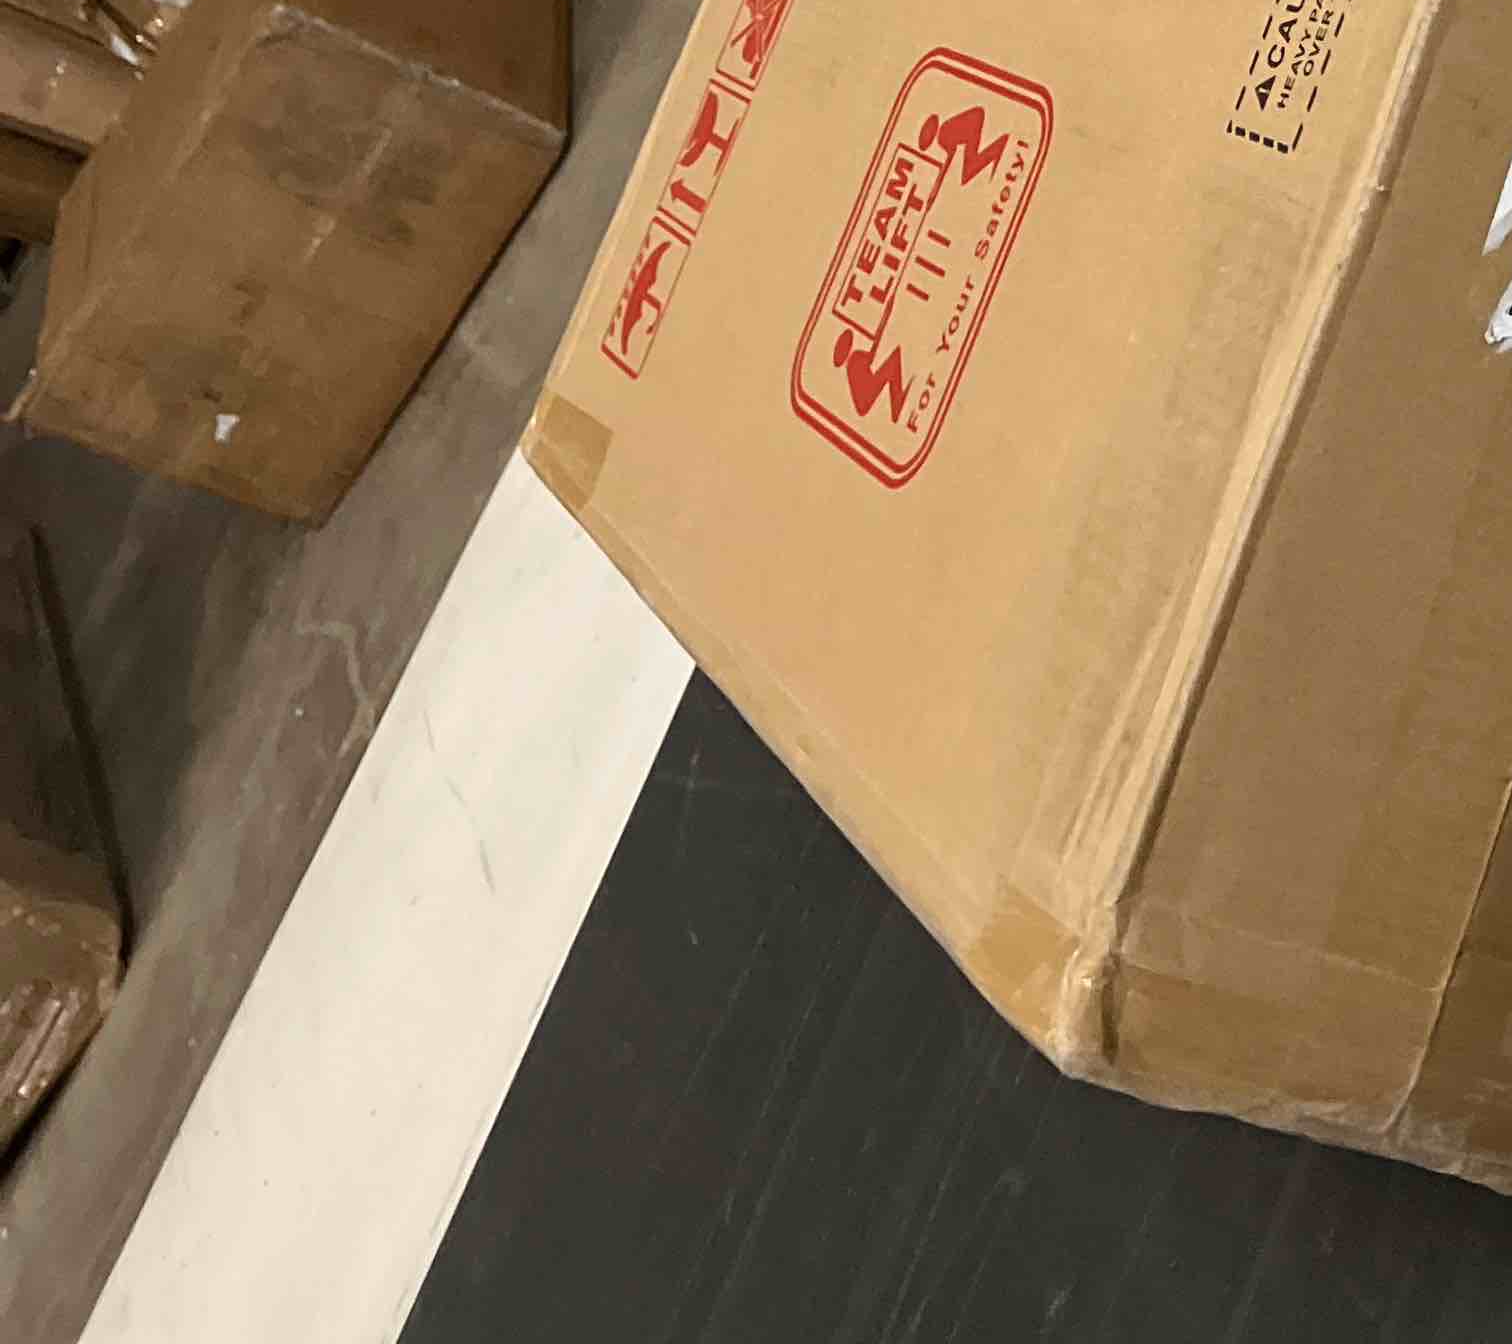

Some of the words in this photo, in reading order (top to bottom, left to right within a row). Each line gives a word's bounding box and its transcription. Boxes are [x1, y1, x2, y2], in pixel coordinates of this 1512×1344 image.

[1276, 28, 1312, 110] HEAVY
[1302, 9, 1335, 77] OVER
[840, 157, 915, 307] TEAM
[869, 183, 925, 305] LIFT
[906, 373, 937, 433] For
[935, 275, 976, 354] Your
[974, 139, 1029, 261] Safety!
